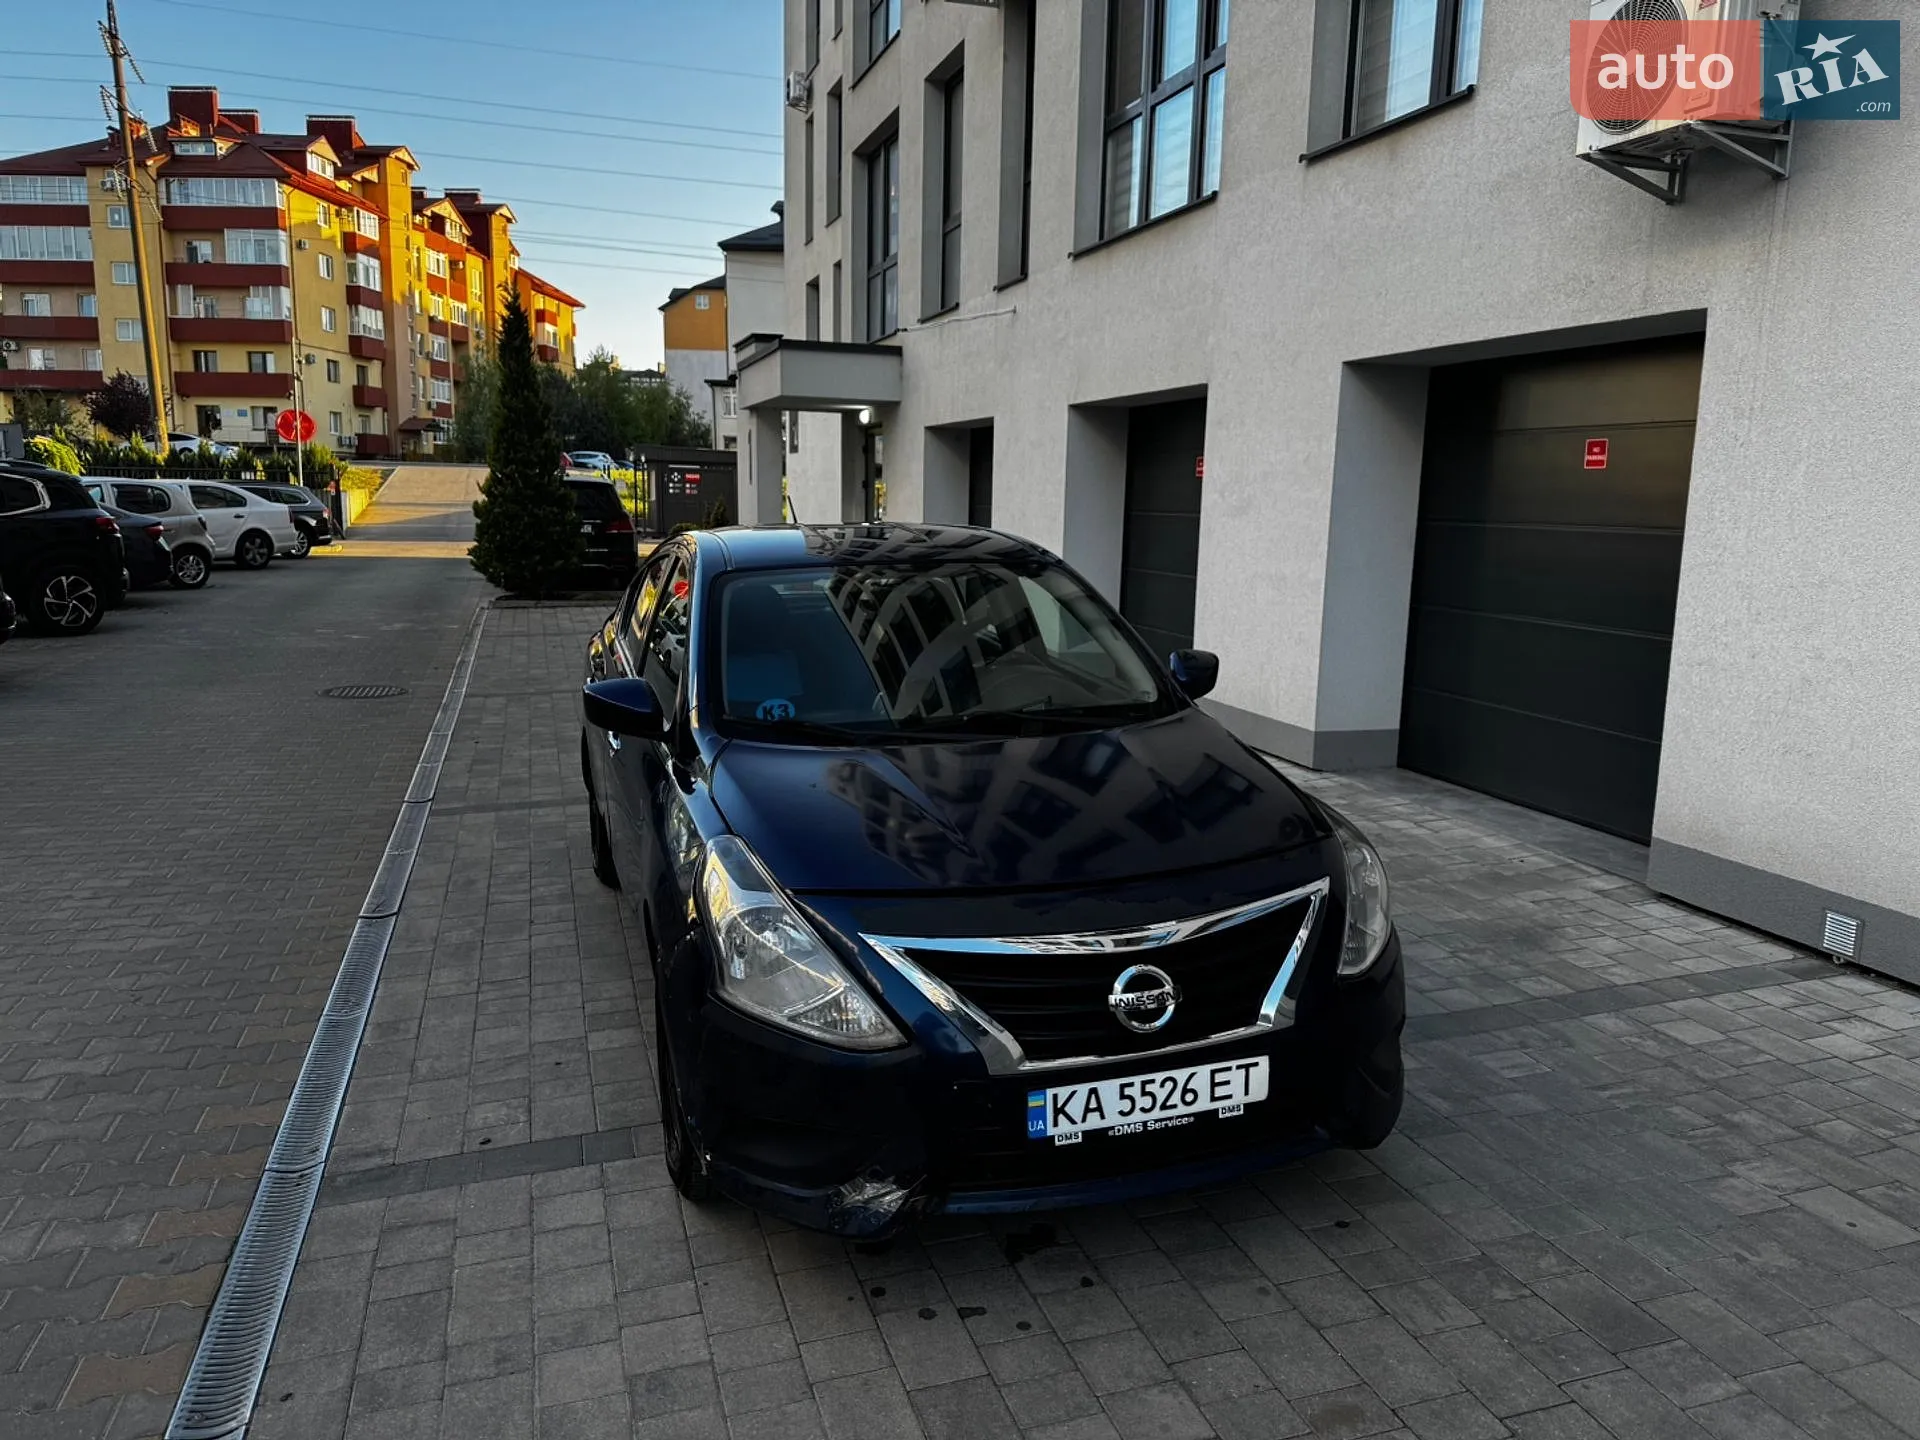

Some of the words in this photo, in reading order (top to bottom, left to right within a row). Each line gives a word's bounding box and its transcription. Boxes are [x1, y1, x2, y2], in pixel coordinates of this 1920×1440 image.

[1052, 1086, 1106, 1128] KA
[1118, 1071, 1199, 1117] 5526
[1210, 1062, 1260, 1103] ET
[1220, 1104, 1242, 1115] DMS
[1029, 1119, 1045, 1132] UA
[1057, 1131, 1081, 1144] DMS
